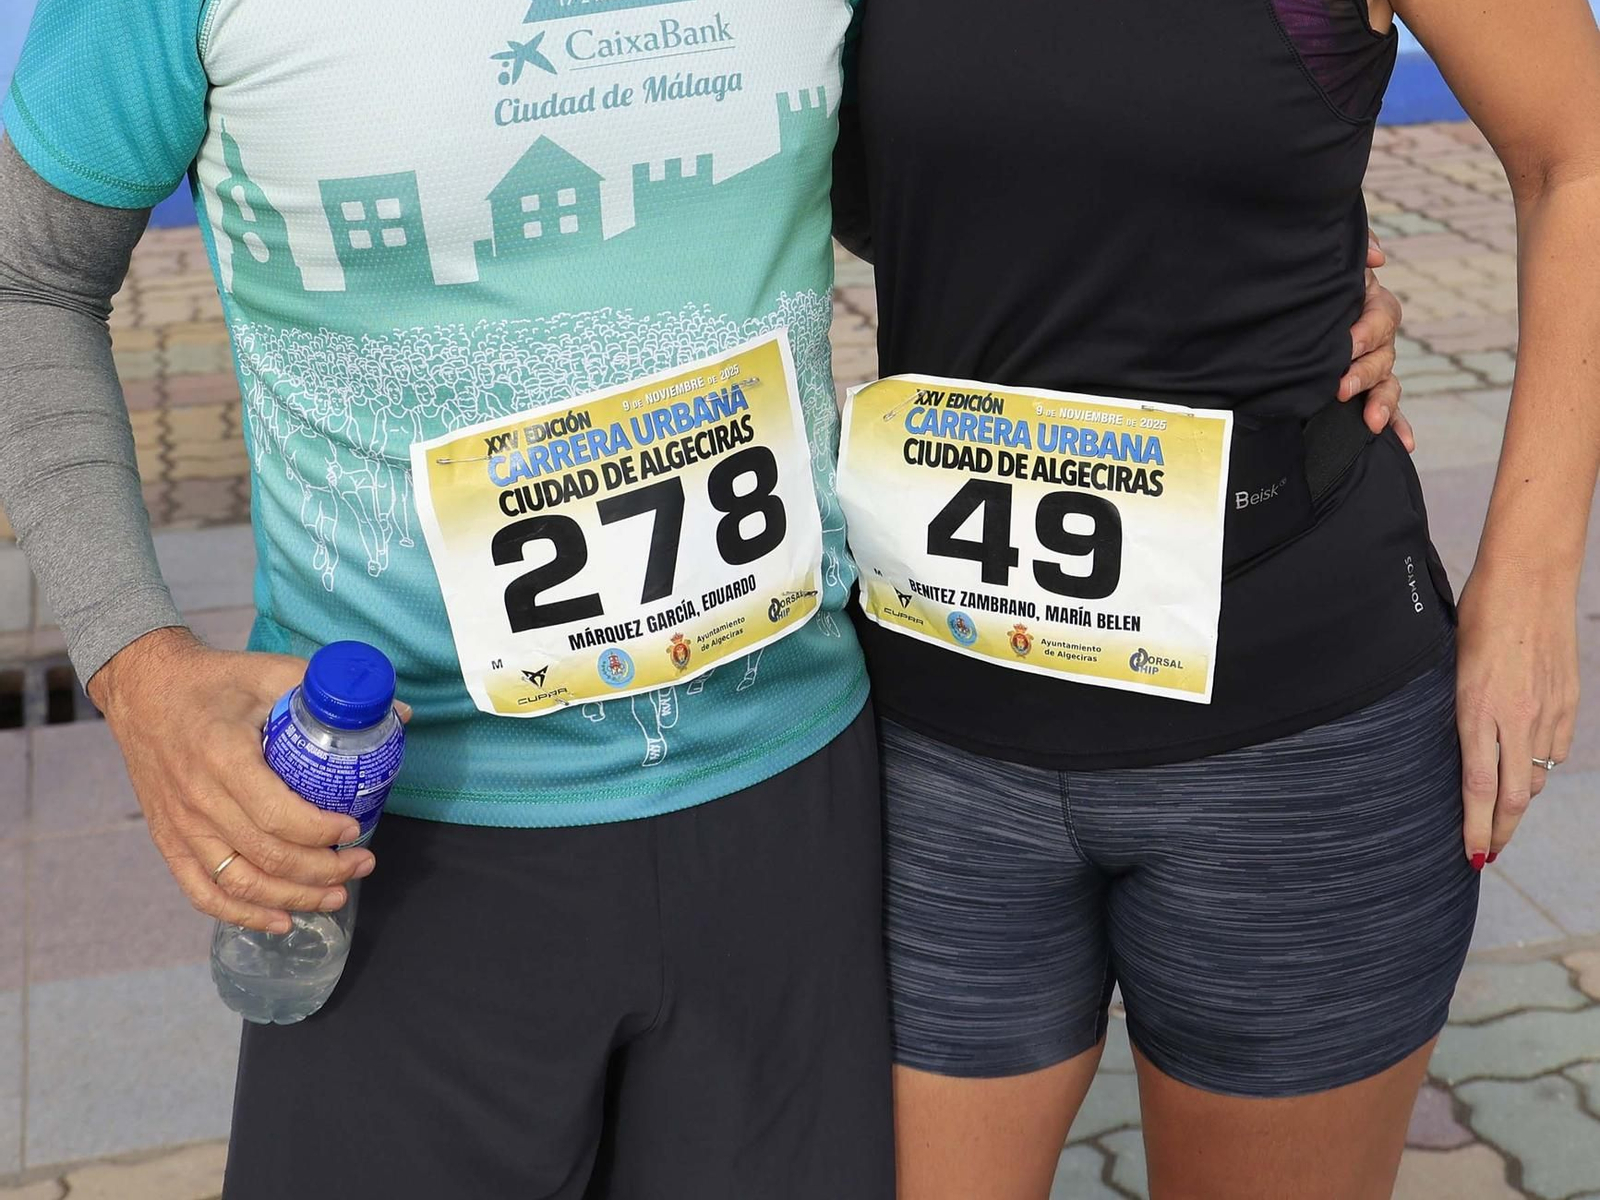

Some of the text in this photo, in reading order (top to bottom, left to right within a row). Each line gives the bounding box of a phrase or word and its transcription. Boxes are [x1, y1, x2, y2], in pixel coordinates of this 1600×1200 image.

[564, 12, 736, 61] CaixaBank
[494, 69, 744, 127] Ciudad de Málaga
[622, 400, 630, 412] 9
[645, 376, 705, 405] NOVIEMBRE
[707, 375, 718, 386] DE
[720, 364, 740, 381] 2025
[913, 388, 1004, 415] XXV EDICIÓN
[484, 409, 592, 457] XXV EDICIÓN
[488, 383, 750, 488] CARRERA URBANA
[904, 406, 1165, 466] CARRERA URBANA
[1035, 405, 1043, 416] 9
[1058, 406, 1123, 425] NOVIEMBRE
[1140, 417, 1168, 431] 2025
[499, 414, 755, 517] CIUDAD DE ALGECIRAS
[903, 437, 1165, 498] CIUDAD DE ALGECIRAS
[491, 445, 788, 633] 278
[926, 478, 1123, 600] 49
[568, 573, 757, 651] MÁRQUEZ GARCÍA, EDUARDO
[883, 607, 924, 626] CUPRA
[908, 578, 1142, 632] BENITEZ ZAMBRANO, MARÍA BELEN
[696, 615, 746, 644] Ayuntamiento
[700, 627, 745, 653] de Algeciras
[1040, 638, 1103, 655] Ayuntamiento
[491, 658, 504, 670] M
[1044, 648, 1098, 663] de Algeciras
